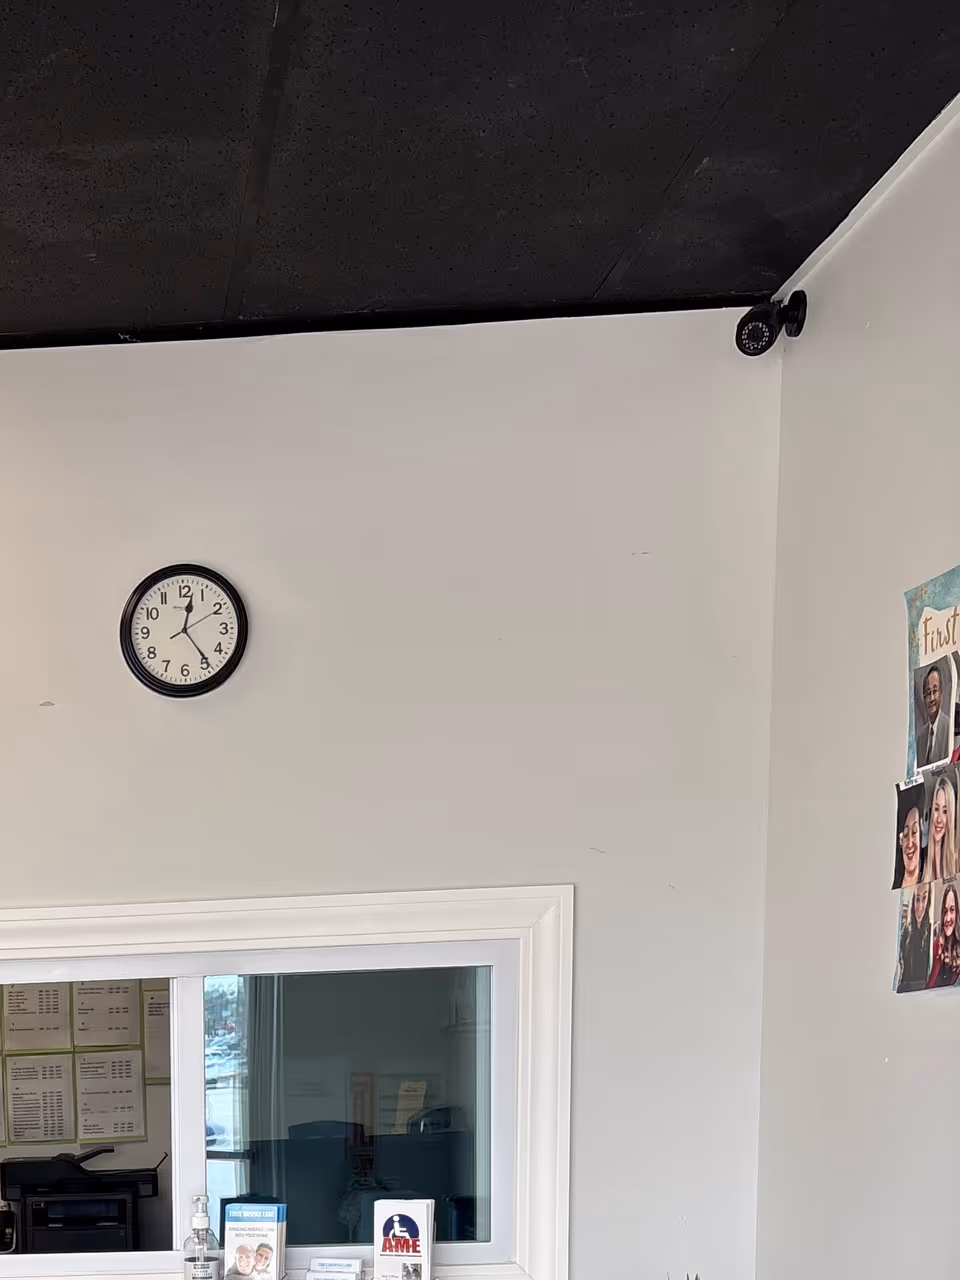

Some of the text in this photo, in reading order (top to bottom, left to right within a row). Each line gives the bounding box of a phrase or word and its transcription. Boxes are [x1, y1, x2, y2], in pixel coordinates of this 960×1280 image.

[160, 591, 167, 605] 11
[178, 585, 192, 598] 12
[146, 607, 159, 620] 10
[213, 602, 223, 615] 2
[140, 626, 150, 640] 9
[219, 622, 229, 635] 3
[922, 606, 960, 656] First
[147, 646, 157, 660] 8
[214, 642, 224, 655] 4
[162, 660, 171, 673] 7
[200, 657, 210, 670] 5
[180, 664, 190, 677] 6
